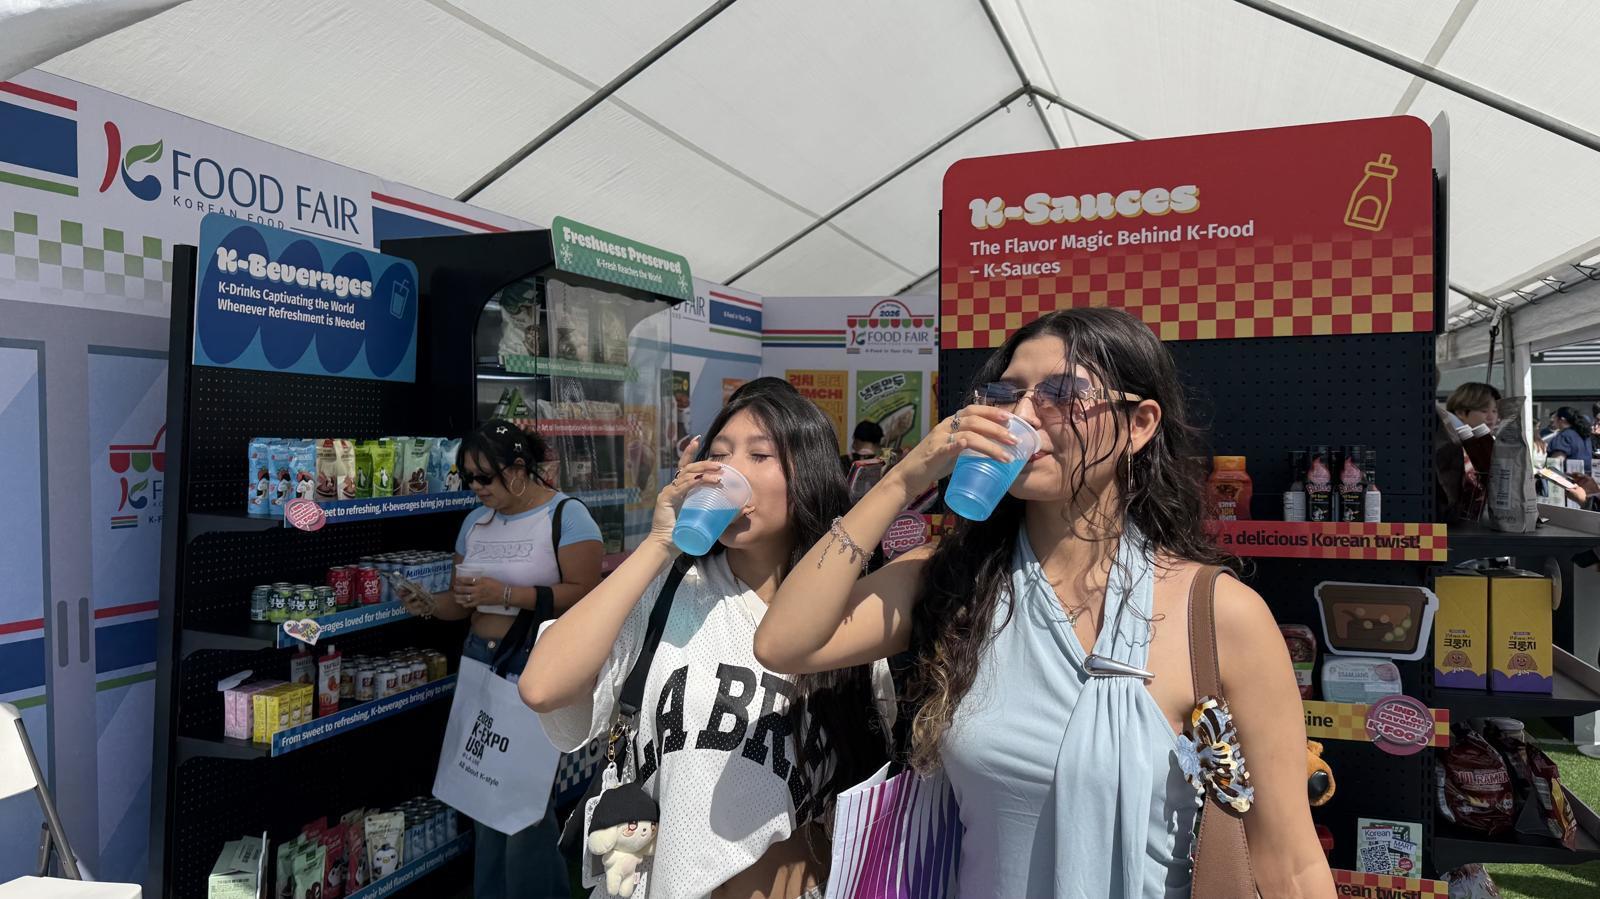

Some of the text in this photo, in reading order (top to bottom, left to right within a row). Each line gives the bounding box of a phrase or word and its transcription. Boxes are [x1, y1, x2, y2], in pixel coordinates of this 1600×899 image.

[172, 149, 284, 214] FOOD
[296, 184, 360, 234] FAIR
[968, 184, 1201, 231] K-Sauces
[562, 226, 682, 274] Freshness Preserved
[970, 220, 1255, 256] The Flavor Magic Behind K-Food
[216, 246, 374, 298] K-Beverages
[984, 260, 1061, 278] K-Sauces
[218, 281, 355, 314] K-Drinks Captivating the World
[217, 299, 366, 331] Whenever Refreshment is Needed
[867, 331, 902, 343] FOOD
[904, 331, 929, 343] FAIR
[800, 387, 844, 399] IMCHI
[324, 507, 337, 518] eet
[337, 506, 345, 517] to
[345, 503, 382, 517] refreshing,
[382, 500, 420, 513] K-beverages
[420, 498, 435, 509] bring
[435, 497, 444, 508] joy
[445, 498, 452, 506] to
[451, 496, 476, 506] everyday
[1223, 533, 1232, 545] a
[1236, 530, 1308, 546] delicious
[1311, 532, 1370, 548] Korean
[1374, 532, 1421, 549] twist!
[320, 620, 344, 632] erages
[344, 615, 364, 627] loved
[364, 612, 375, 623] for
[375, 609, 391, 620] their
[391, 605, 406, 617] bold
[281, 733, 301, 747] From
[302, 725, 324, 740] sweet
[325, 721, 334, 732] to
[334, 711, 370, 728] refreshing,
[371, 697, 409, 717] K-beverages
[409, 691, 425, 704] bring
[425, 688, 435, 699] joy
[476, 709, 494, 729] 2026
[465, 735, 485, 760] USA
[471, 720, 510, 753] K-EXPO
[479, 772, 499, 787] K-style
[1364, 829, 1391, 837] Korean
[1394, 840, 1414, 851] MART
[1336, 881, 1372, 899] rean
